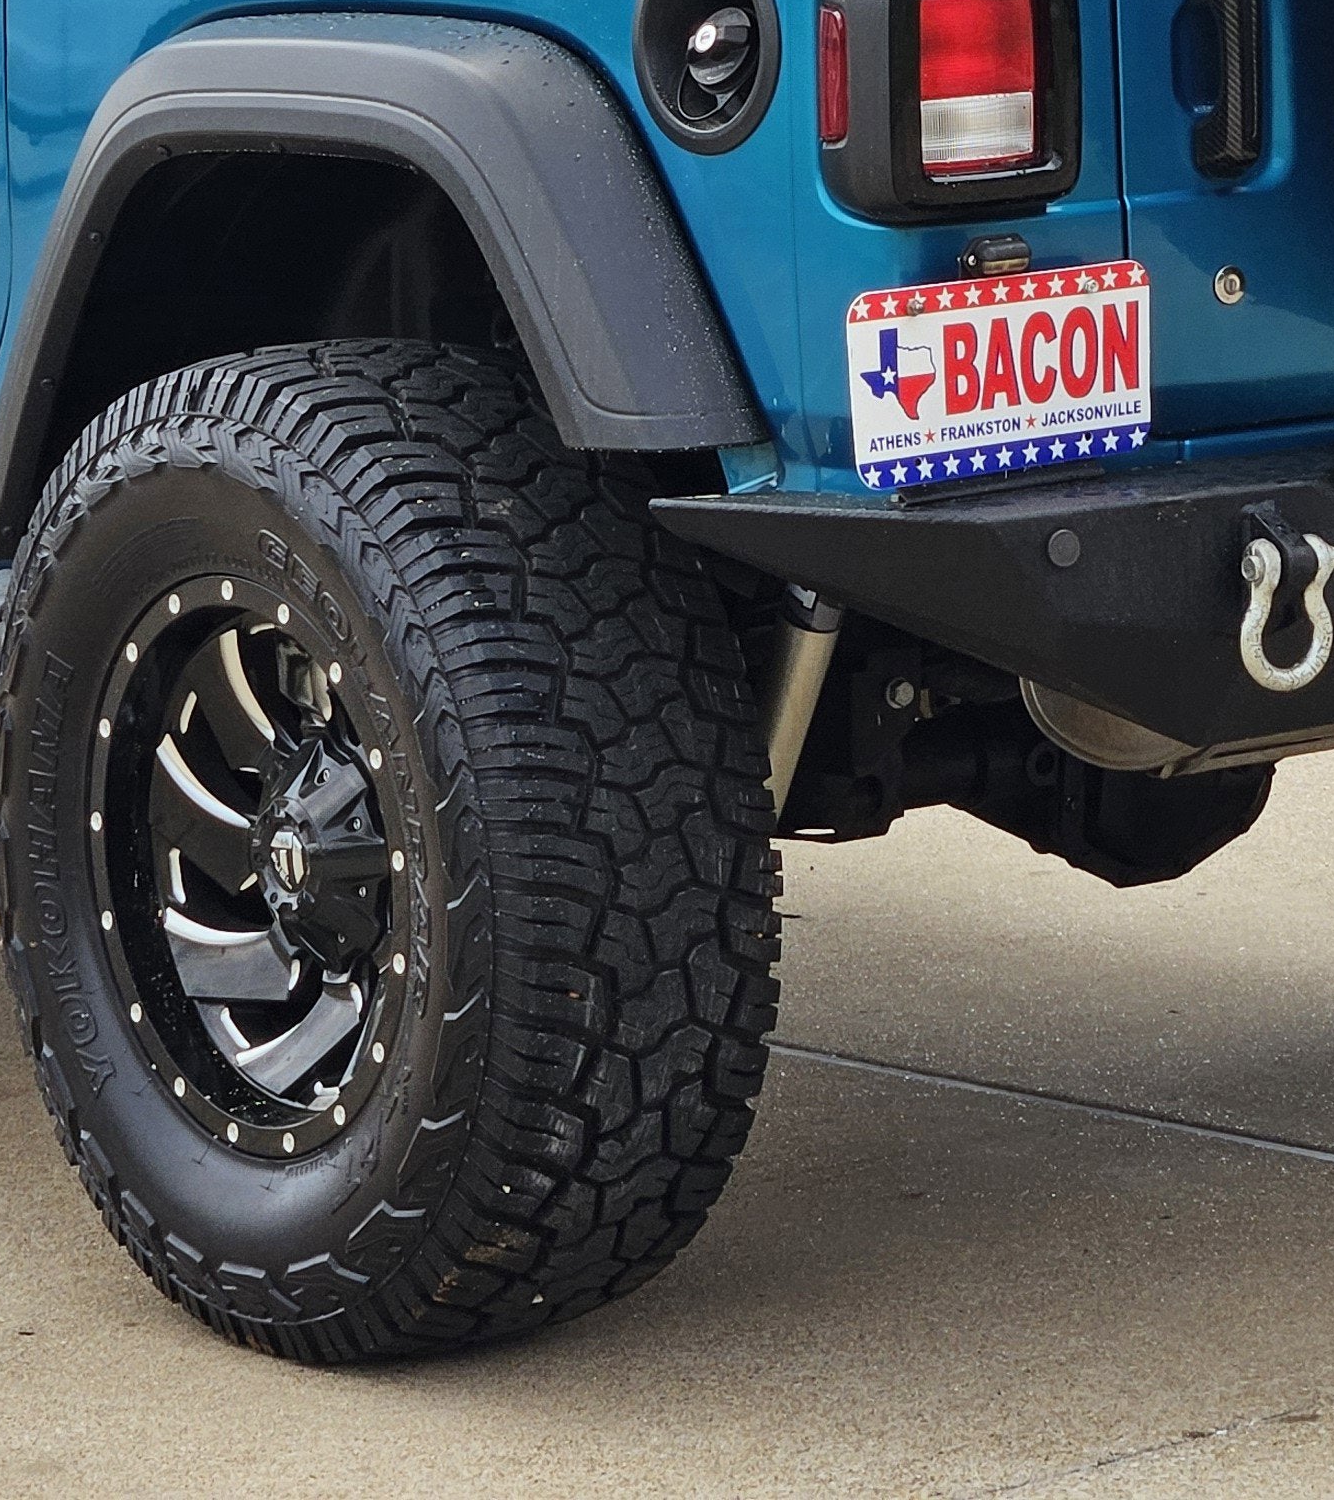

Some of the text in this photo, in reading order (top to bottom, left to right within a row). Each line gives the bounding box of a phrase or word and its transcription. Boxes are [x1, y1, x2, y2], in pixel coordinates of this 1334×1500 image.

[943, 301, 1139, 415] BACON
[869, 401, 1142, 453] ATHENS FRANKSTON JACKSONVILLE
[27, 649, 117, 1094] YOKOHAMA
